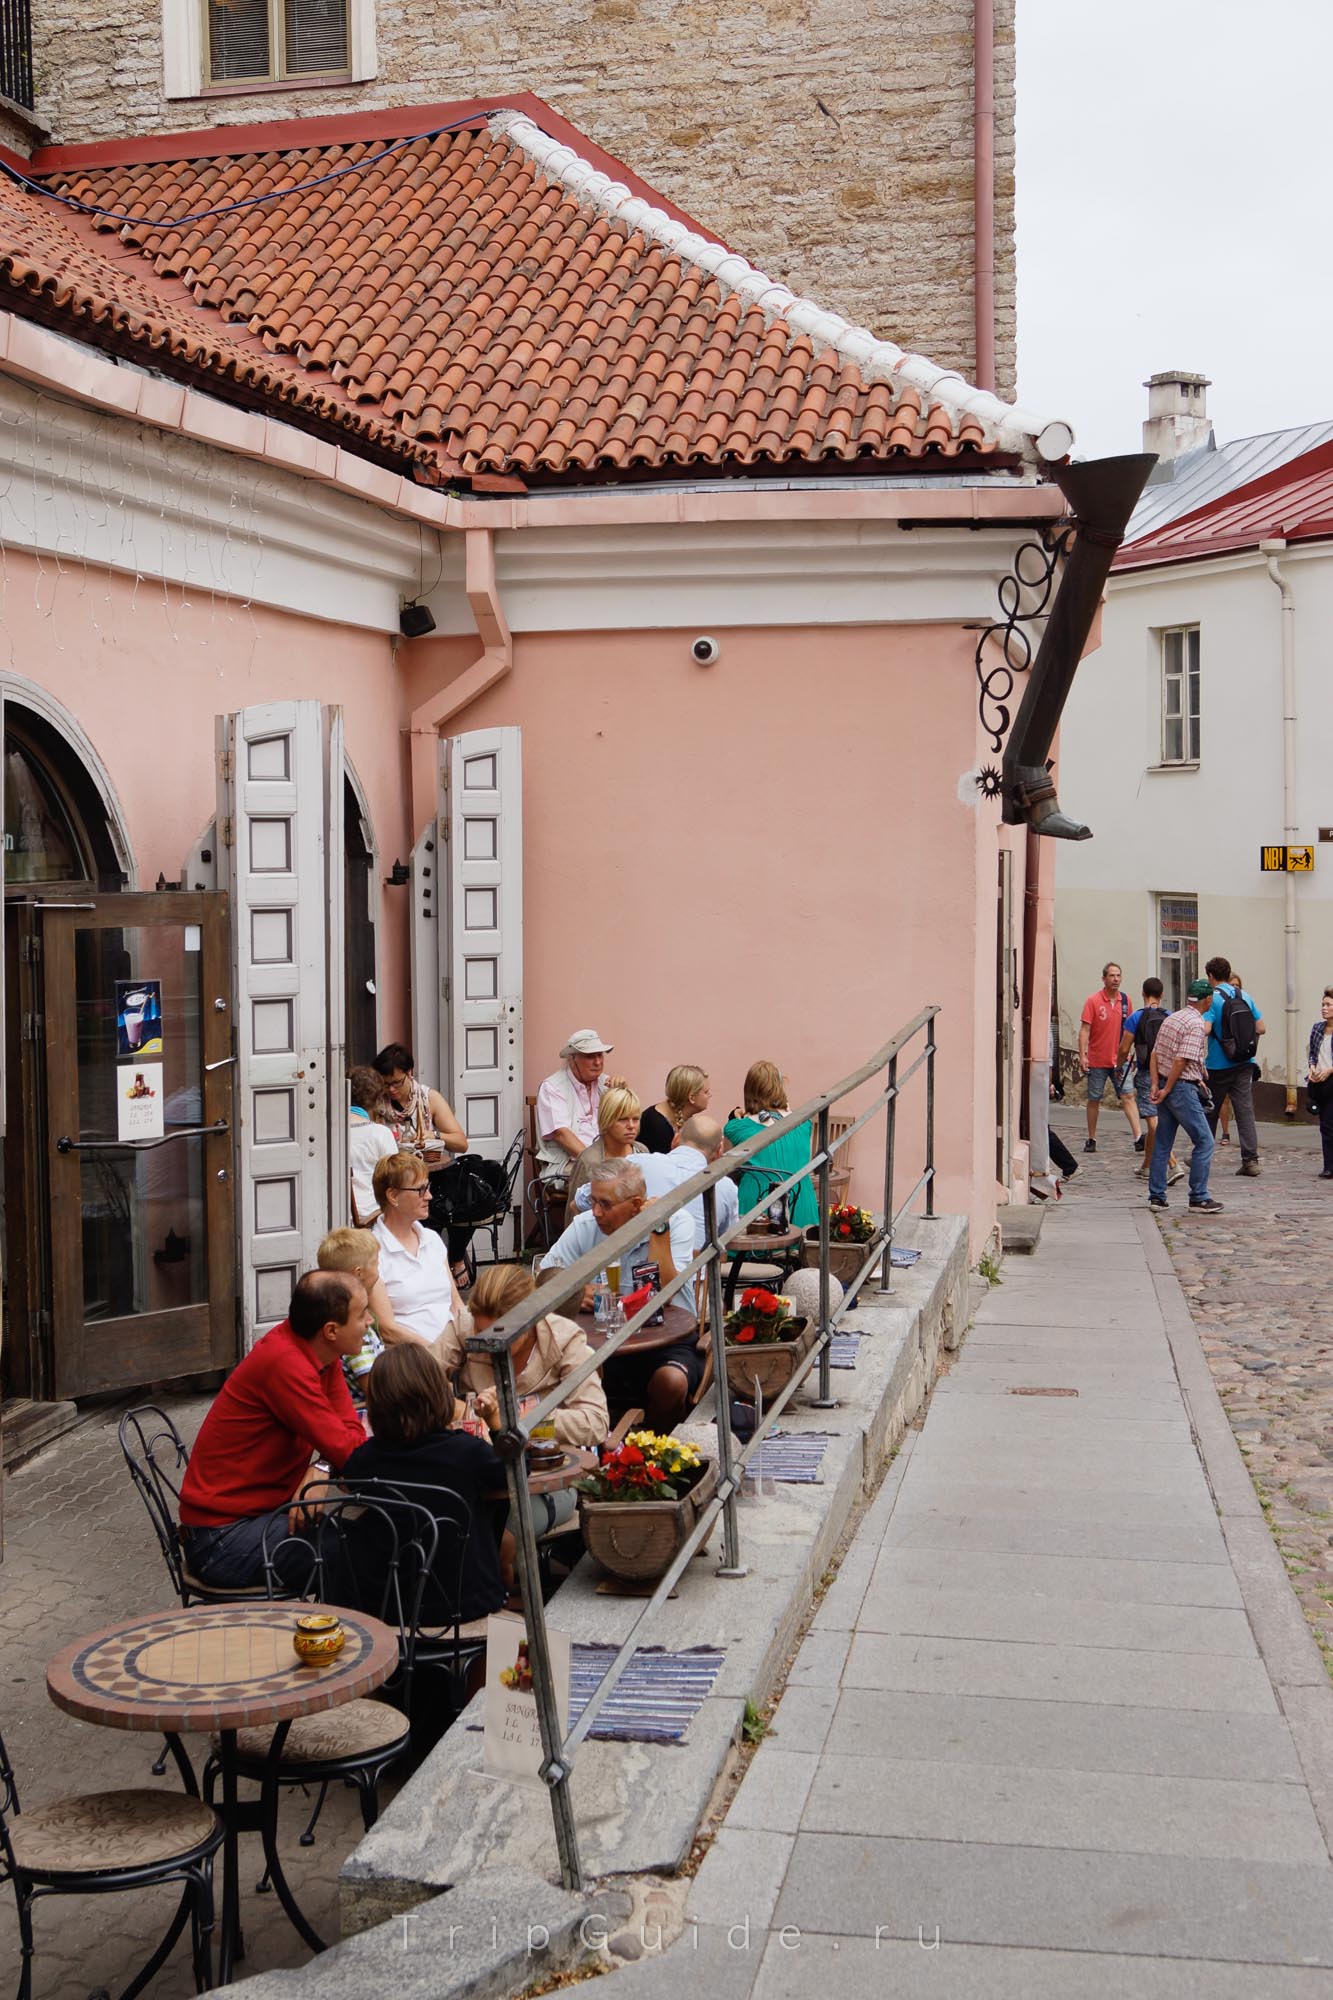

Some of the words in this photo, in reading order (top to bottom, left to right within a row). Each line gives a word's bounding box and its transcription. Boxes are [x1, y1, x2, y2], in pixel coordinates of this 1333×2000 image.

[1264, 847, 1283, 870] NB!
[1099, 1005, 1107, 1021] 3
[505, 1703, 537, 1721] SANGR
